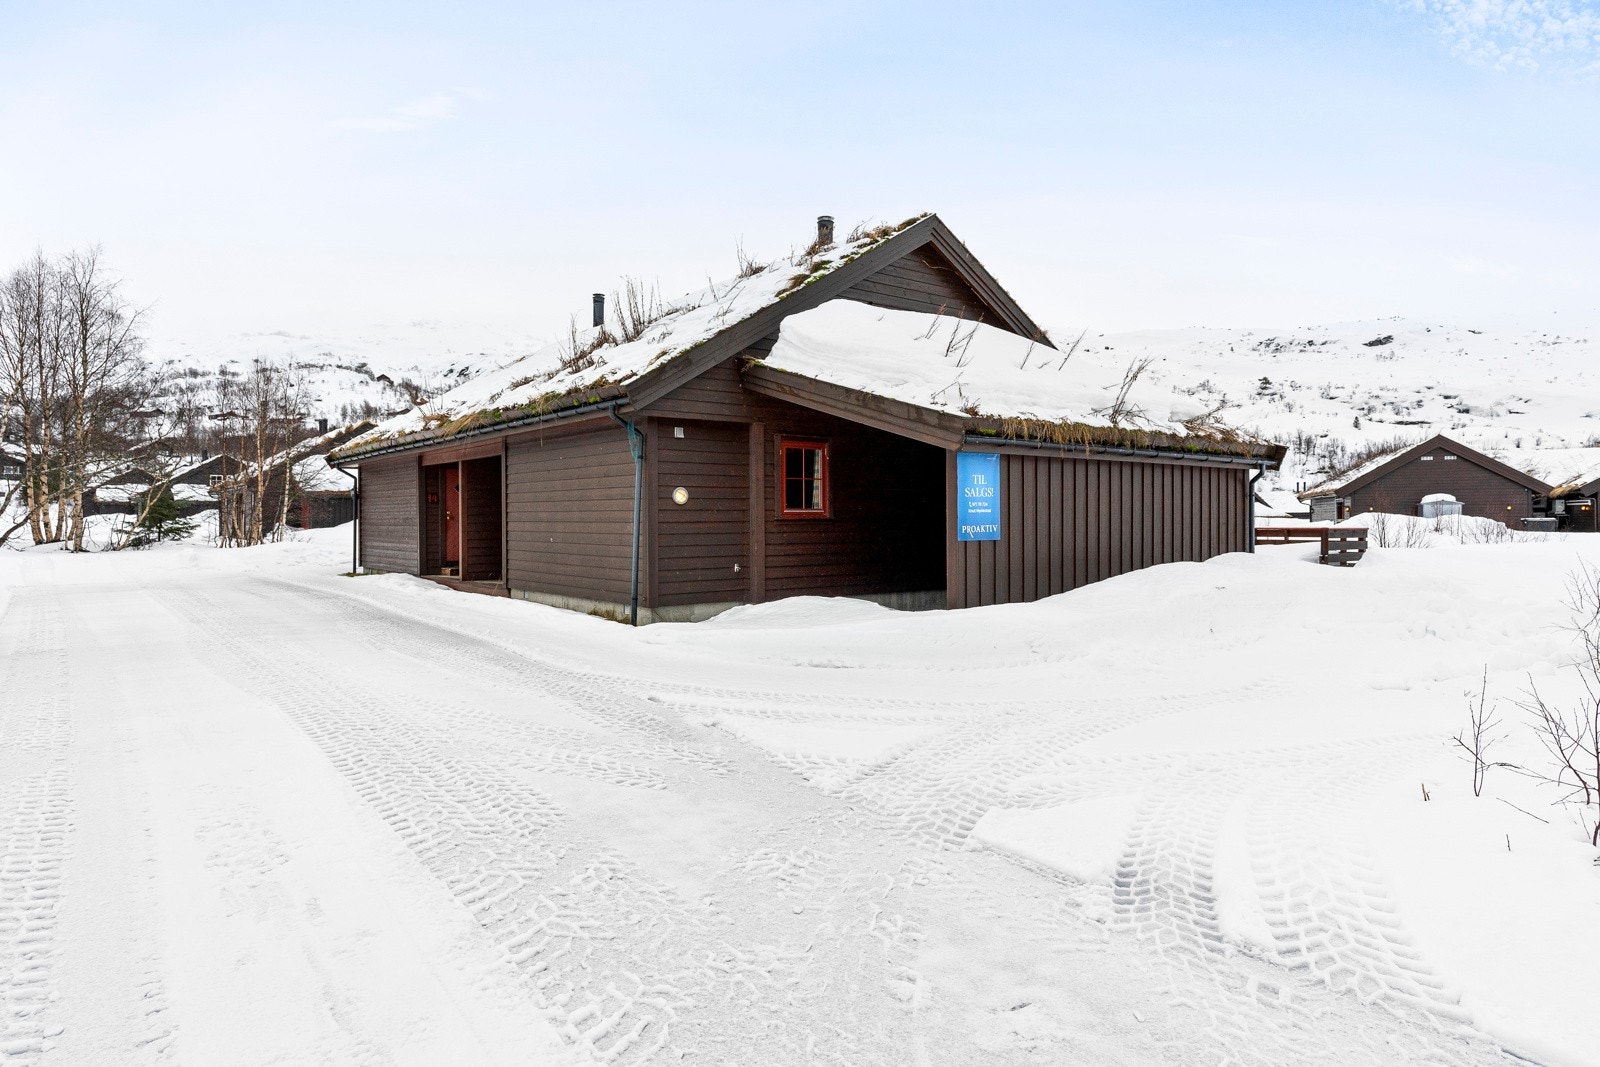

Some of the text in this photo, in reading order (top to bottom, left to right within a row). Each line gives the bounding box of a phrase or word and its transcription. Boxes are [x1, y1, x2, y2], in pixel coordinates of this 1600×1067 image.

[972, 474, 987, 485] TIL
[964, 487, 994, 497] SALGS!
[962, 525, 998, 537] PROAKTIV
